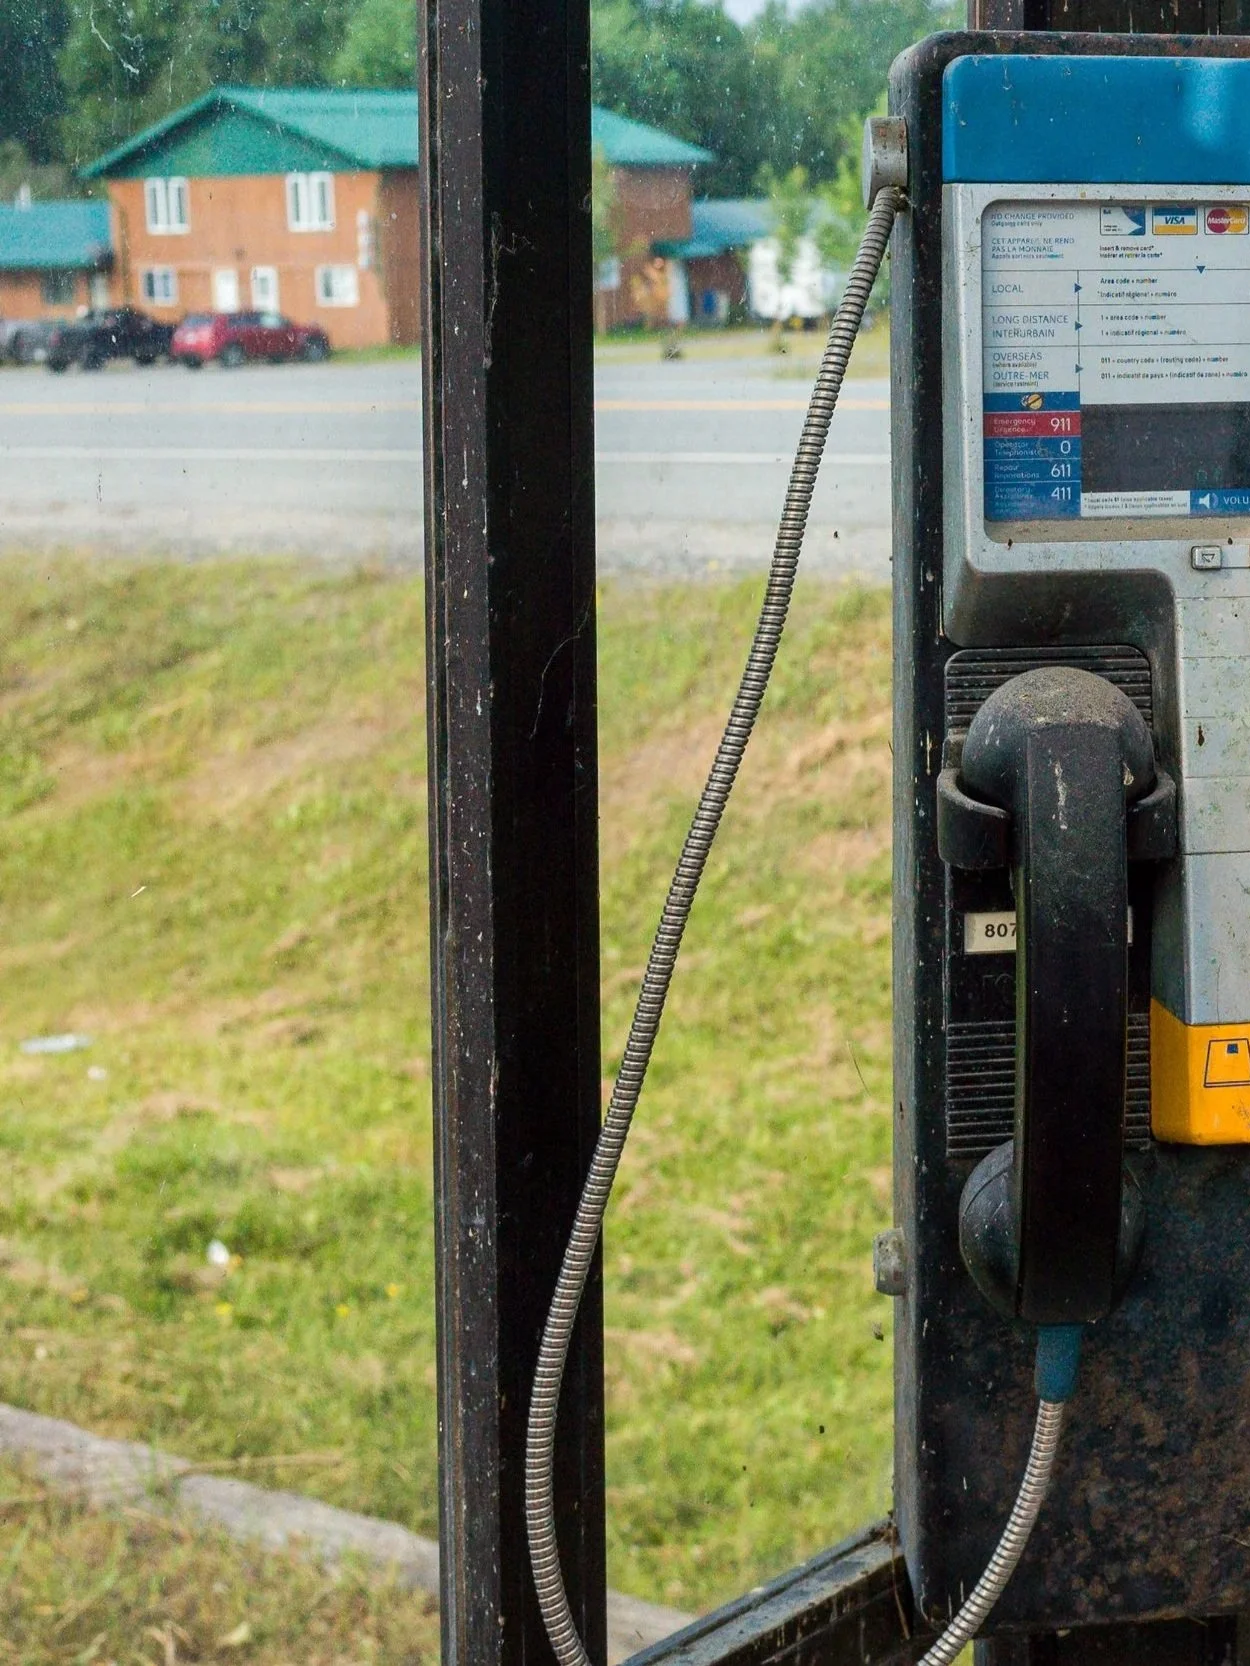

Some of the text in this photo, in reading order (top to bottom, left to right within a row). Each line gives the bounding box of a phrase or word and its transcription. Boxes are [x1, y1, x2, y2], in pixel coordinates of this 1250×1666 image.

[1208, 217, 1246, 225] MasterCard
[992, 284, 1024, 292] LOCAL
[992, 315, 1069, 324] LONG DISTANCE
[992, 330, 1055, 338] INTERURBAIN
[993, 352, 1042, 360] OVERSEAS
[993, 371, 1049, 380] OUTRE-MER
[1050, 418, 1070, 432] 911
[1060, 440, 1071, 454] 0
[1051, 464, 1071, 478] 611
[1051, 487, 1072, 500] 411
[984, 923, 1016, 938] 807
